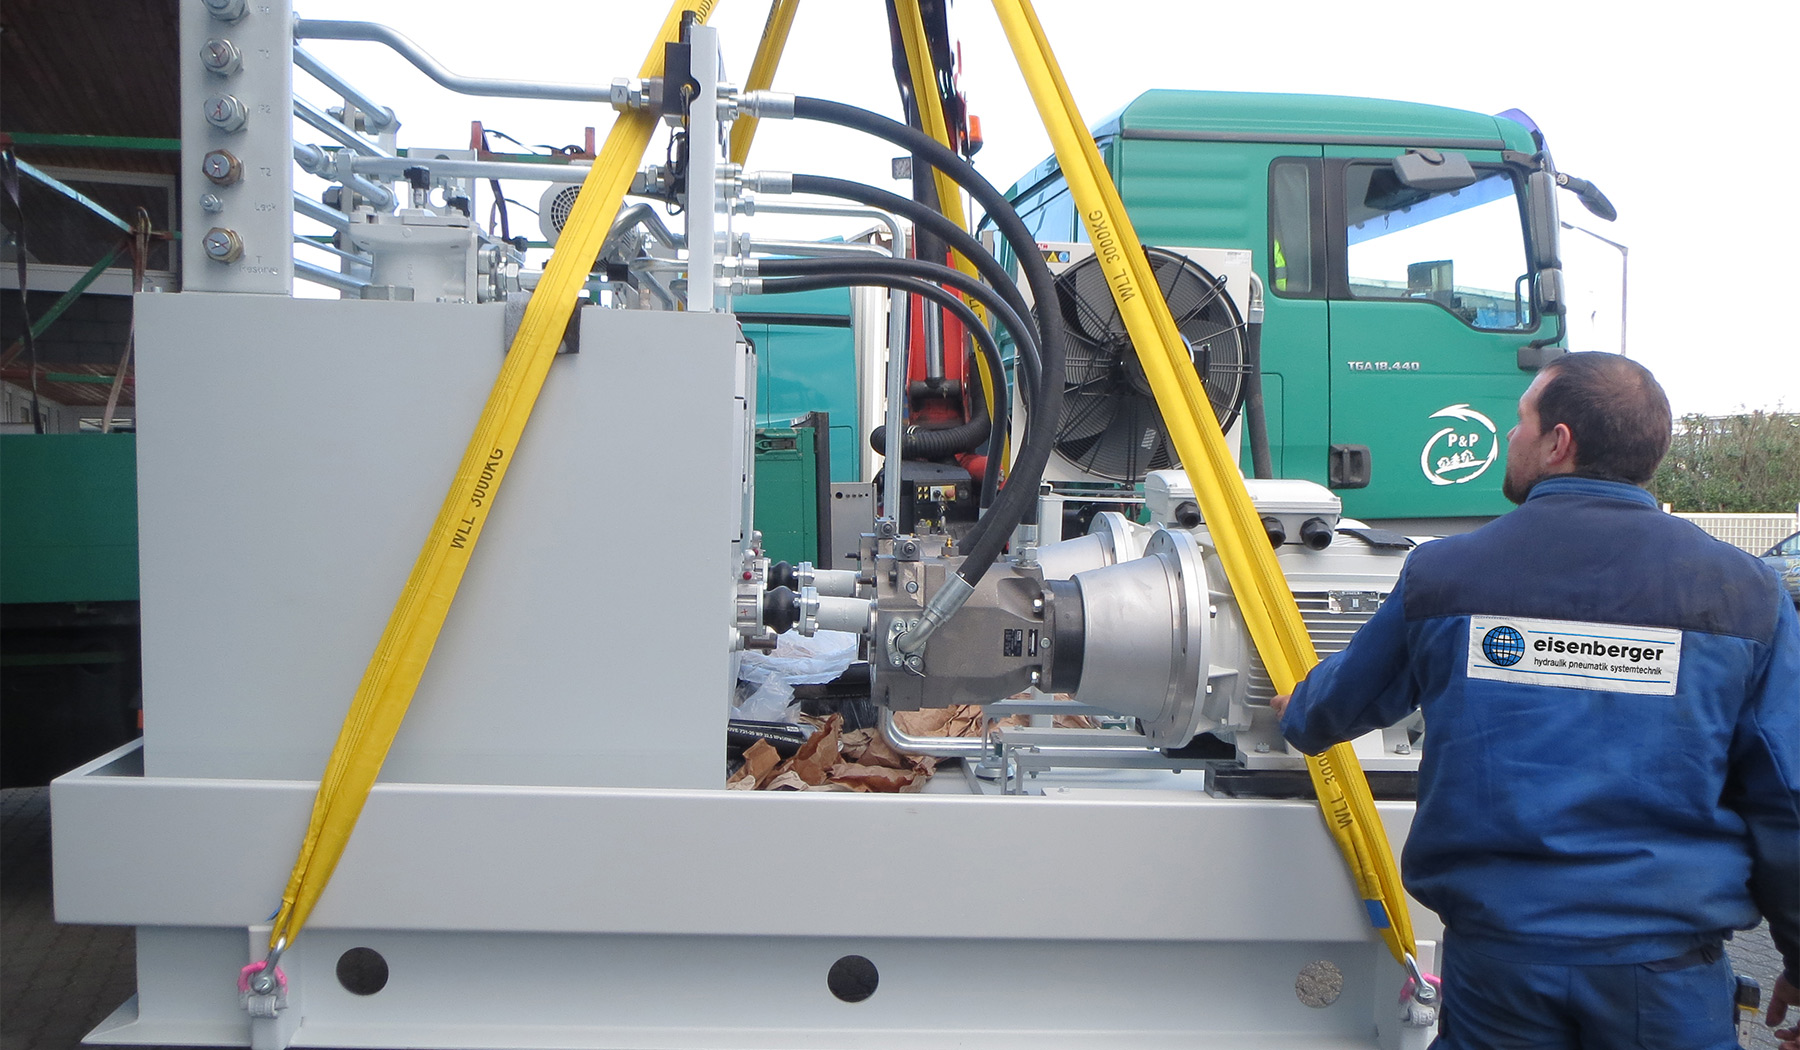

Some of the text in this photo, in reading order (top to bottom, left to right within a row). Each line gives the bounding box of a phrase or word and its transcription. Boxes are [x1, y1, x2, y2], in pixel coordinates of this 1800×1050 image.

[259, 167, 272, 177] T2
[1088, 210, 1135, 303] WLL 3000KG
[1347, 361, 1421, 371] TGA 18.440
[1447, 432, 1480, 448] P&P
[450, 516, 476, 549] WLL
[1533, 637, 1664, 662] eisenberger
[1534, 657, 1663, 675] hydraulik pneumatik systemtechnik
[1331, 791, 1353, 829] WLL
